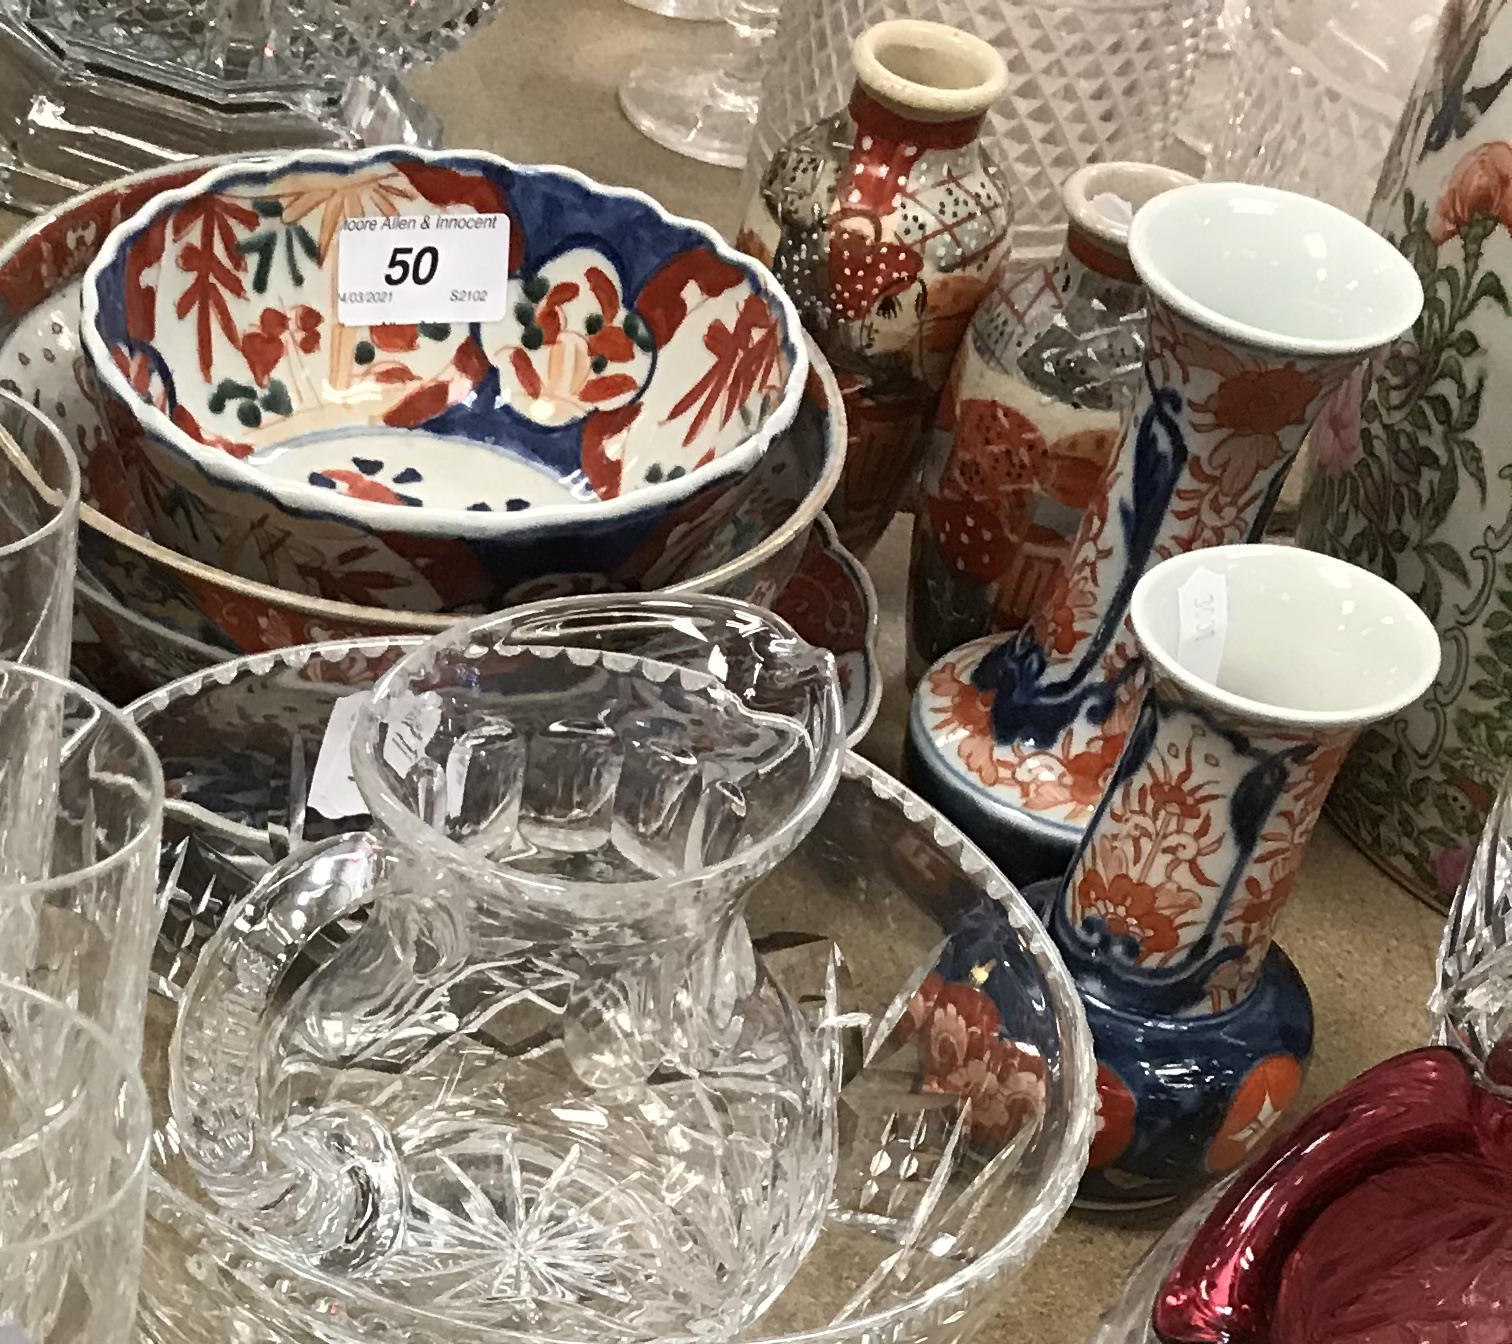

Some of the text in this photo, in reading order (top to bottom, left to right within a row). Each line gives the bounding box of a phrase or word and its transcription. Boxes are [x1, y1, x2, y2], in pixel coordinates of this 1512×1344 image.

[381, 216, 417, 230] Allen
[420, 216, 431, 230] &
[436, 215, 498, 230] Innocent
[384, 246, 439, 286] 50
[449, 289, 488, 302] S2102
